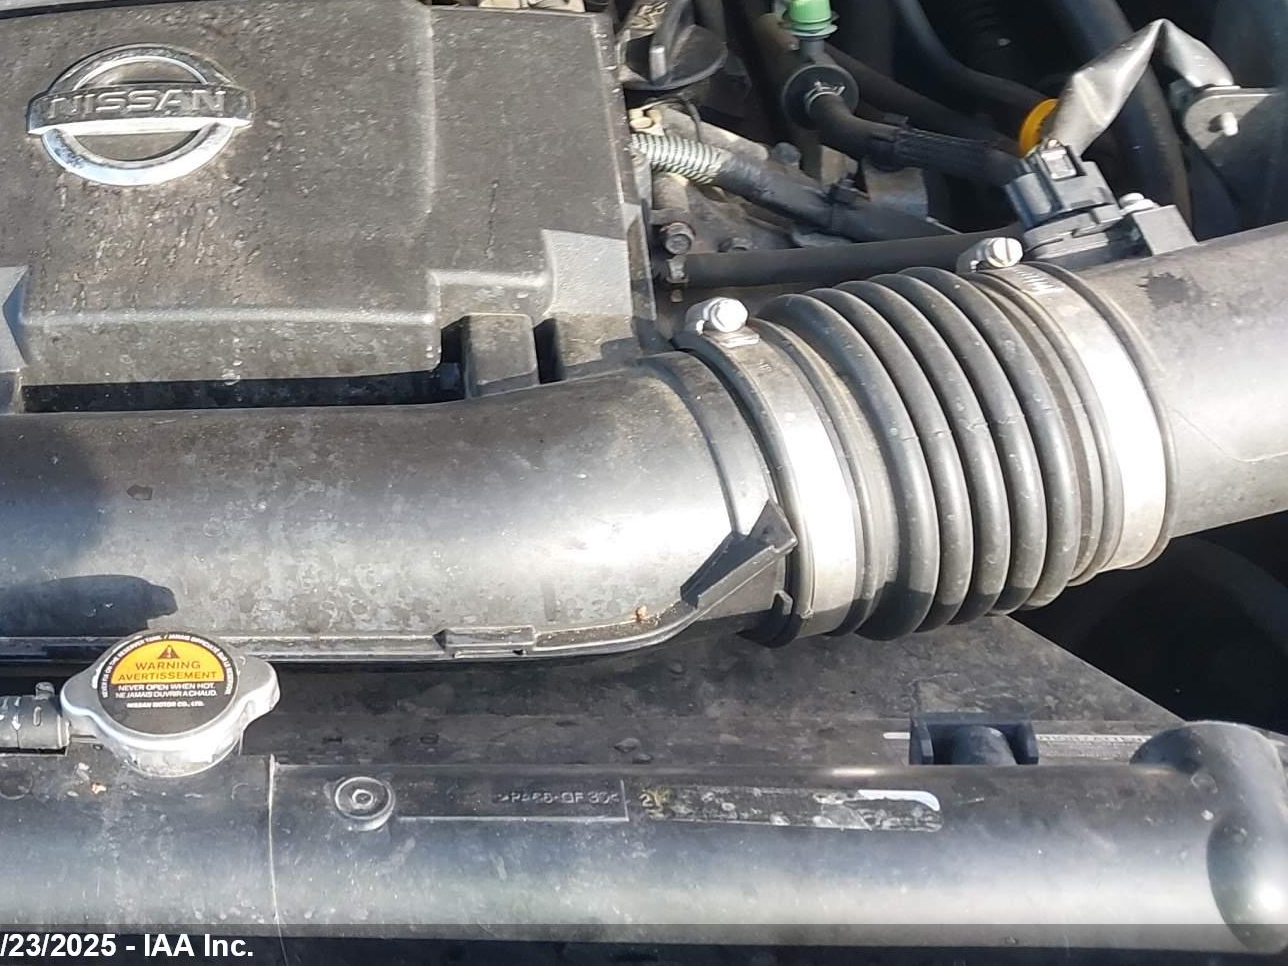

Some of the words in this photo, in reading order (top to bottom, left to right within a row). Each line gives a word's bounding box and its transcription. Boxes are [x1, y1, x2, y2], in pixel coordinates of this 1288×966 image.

[47, 89, 226, 120] NISSAN
[135, 661, 201, 671] WARNING
[118, 671, 217, 681] AVERTISSEMENT
